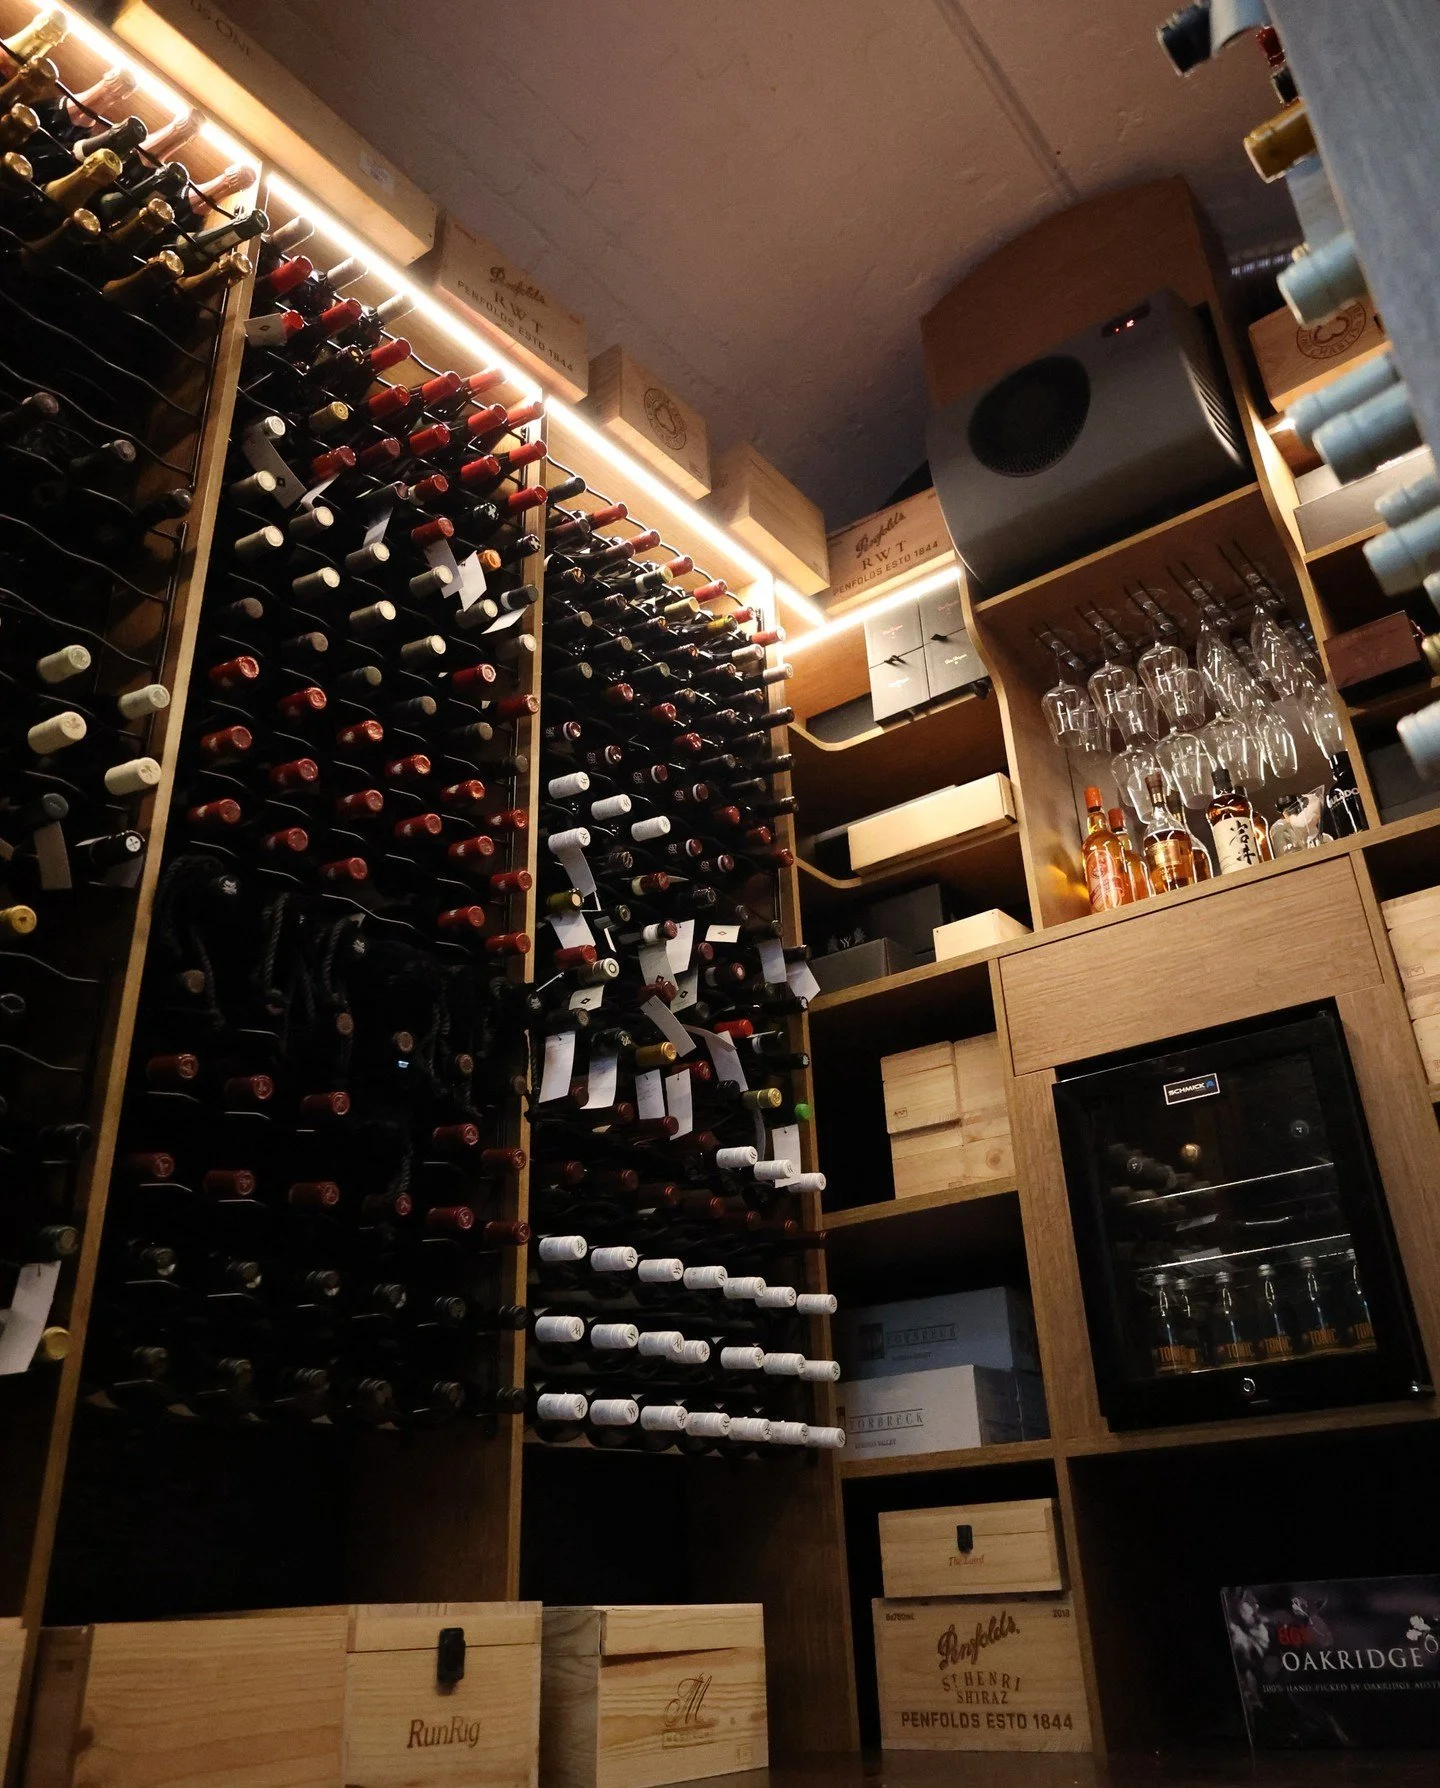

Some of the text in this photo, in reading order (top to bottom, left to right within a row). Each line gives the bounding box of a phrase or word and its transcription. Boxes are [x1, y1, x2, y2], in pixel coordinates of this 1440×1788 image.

[457, 280, 515, 328] PENFOLDS
[549, 348, 574, 372] 1844
[833, 540, 939, 596] PENFOLDS ESTD 1844
[1168, 1082, 1206, 1096] SCHMICK
[850, 1412, 923, 1431] TORBRECK
[1282, 1647, 1424, 1671] OAKRIDGE
[964, 1672, 1021, 1692] HENRI
[1286, 1683, 1312, 1692] HAND
[1315, 1682, 1348, 1692] PICKED
[1351, 1682, 1361, 1692] BY
[1364, 1681, 1411, 1690] OAKRIDGE
[957, 1691, 1009, 1705] SHIRAZ
[901, 1711, 1074, 1731] PENFOLDS ESTD 1844
[407, 1715, 481, 1749] RunRig
